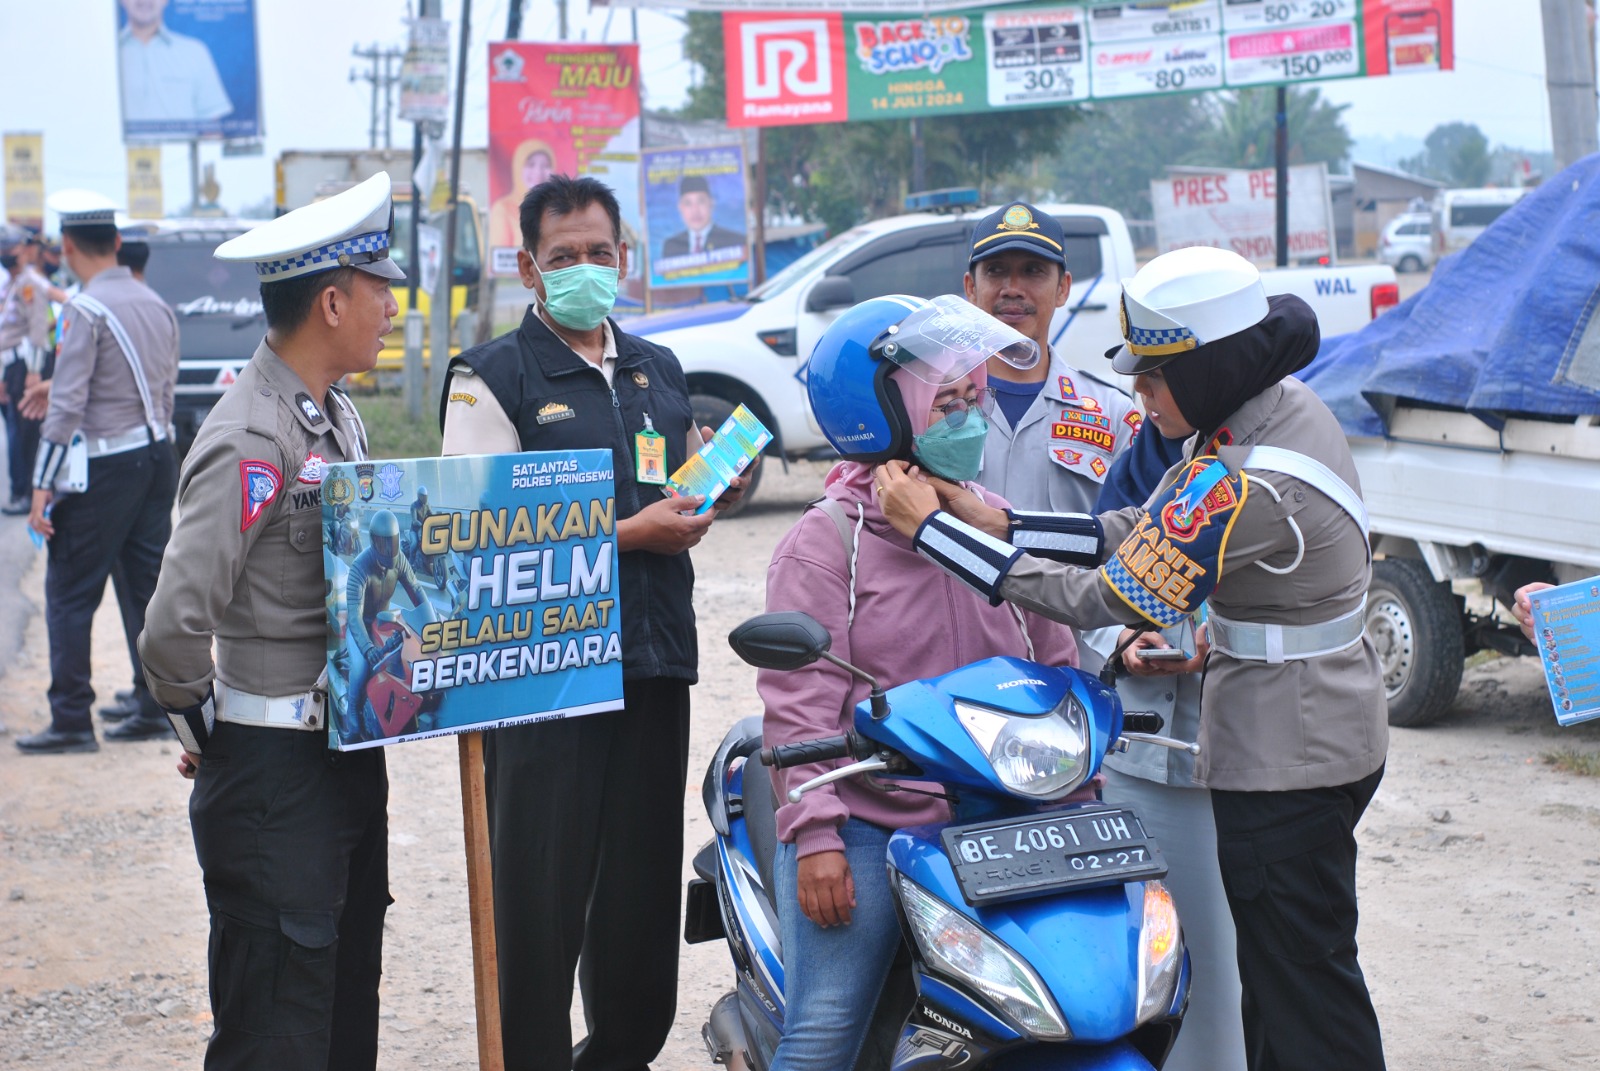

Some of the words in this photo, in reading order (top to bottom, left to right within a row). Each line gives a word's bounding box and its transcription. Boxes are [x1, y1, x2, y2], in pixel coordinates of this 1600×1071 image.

[858, 20, 923, 47] BACK
[933, 17, 964, 36] TO
[870, 40, 970, 73] SCHOOL
[560, 64, 632, 89] MAJU
[888, 80, 945, 95] HINGGA
[1023, 67, 1074, 92] 30%
[744, 102, 832, 118] Ramayana
[872, 98, 892, 109] 14
[897, 97, 923, 108] JULI
[925, 95, 963, 107] 2024
[1173, 174, 1230, 207] PRES
[1248, 171, 1292, 199] PE
[1314, 278, 1357, 296] WAL
[1055, 425, 1112, 447] DISHUB
[511, 475, 552, 489] POLRES
[555, 470, 614, 486] PRINGSEWU
[512, 460, 578, 477] SATLANTAS
[421, 497, 615, 556] GUNAKAN
[467, 541, 613, 612] HELM
[420, 609, 534, 653] SELALU
[542, 599, 615, 637] SAAT
[411, 632, 623, 694] BERKENDARA
[996, 679, 1048, 690] HONDA
[1014, 823, 1081, 854] 4061
[1092, 817, 1131, 842] UH
[923, 1006, 973, 1040] HONDA
[910, 1029, 965, 1059] FI
